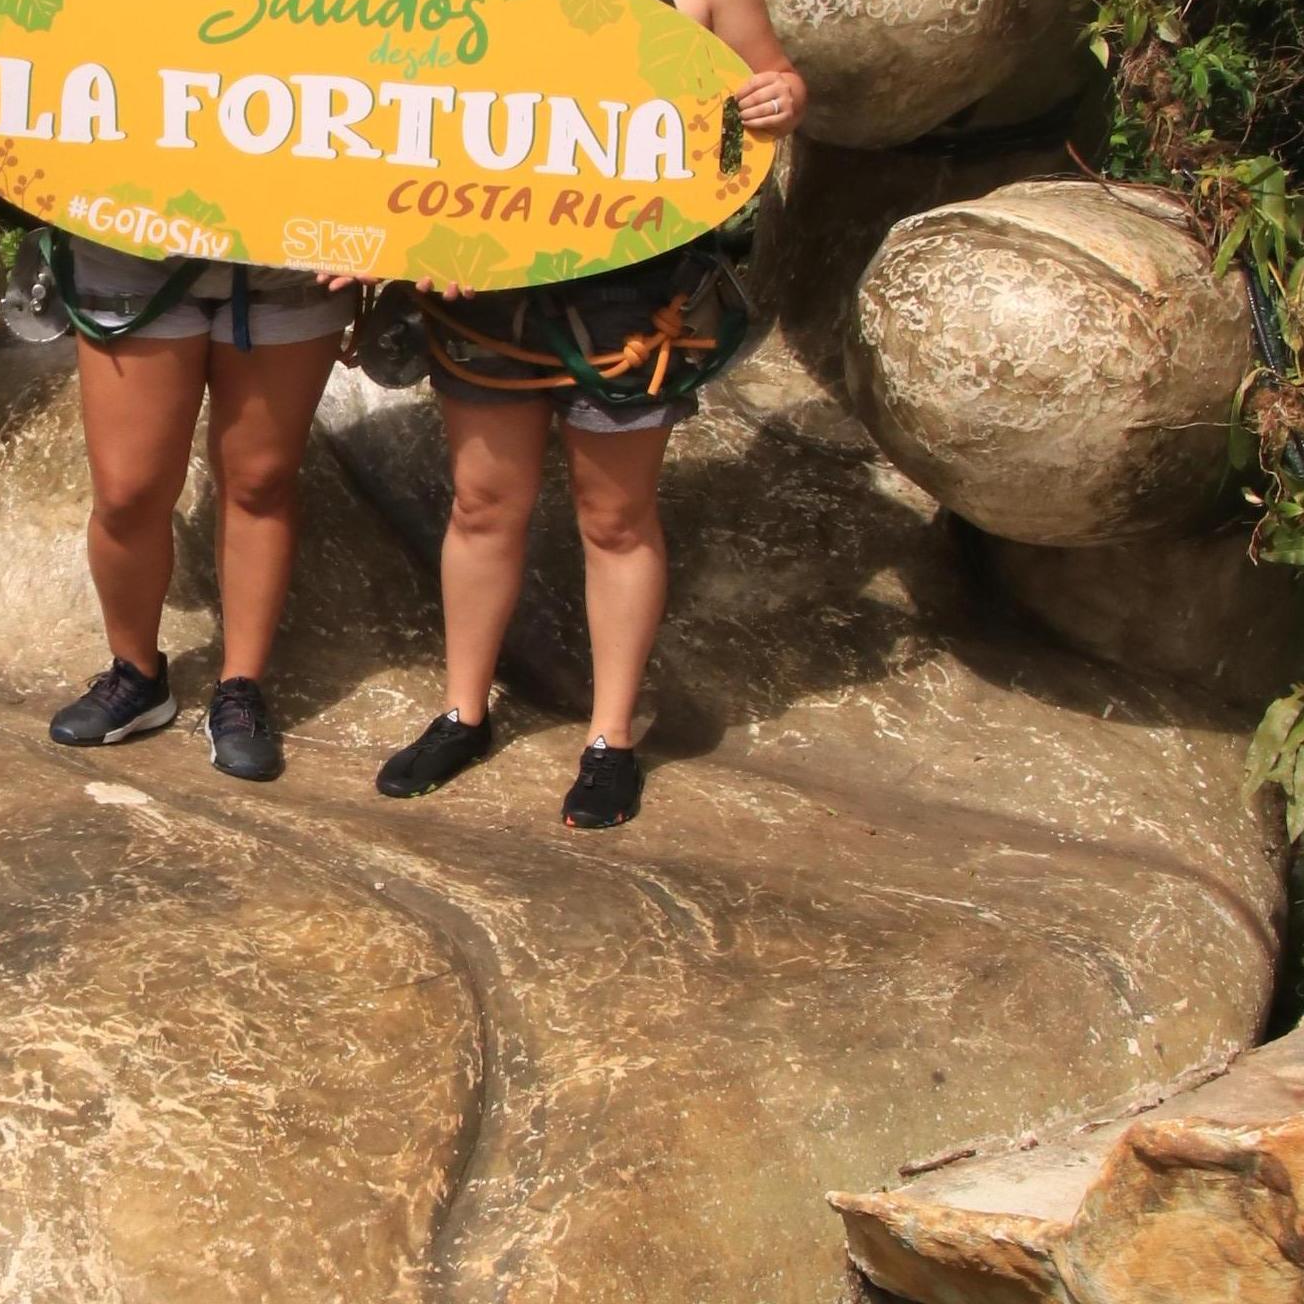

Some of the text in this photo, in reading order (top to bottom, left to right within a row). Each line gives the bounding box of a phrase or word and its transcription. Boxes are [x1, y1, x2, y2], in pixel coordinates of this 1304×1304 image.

[367, 32, 457, 80] desde
[155, 68, 696, 183] FORTUNA
[387, 180, 664, 232] COSTA RICA
